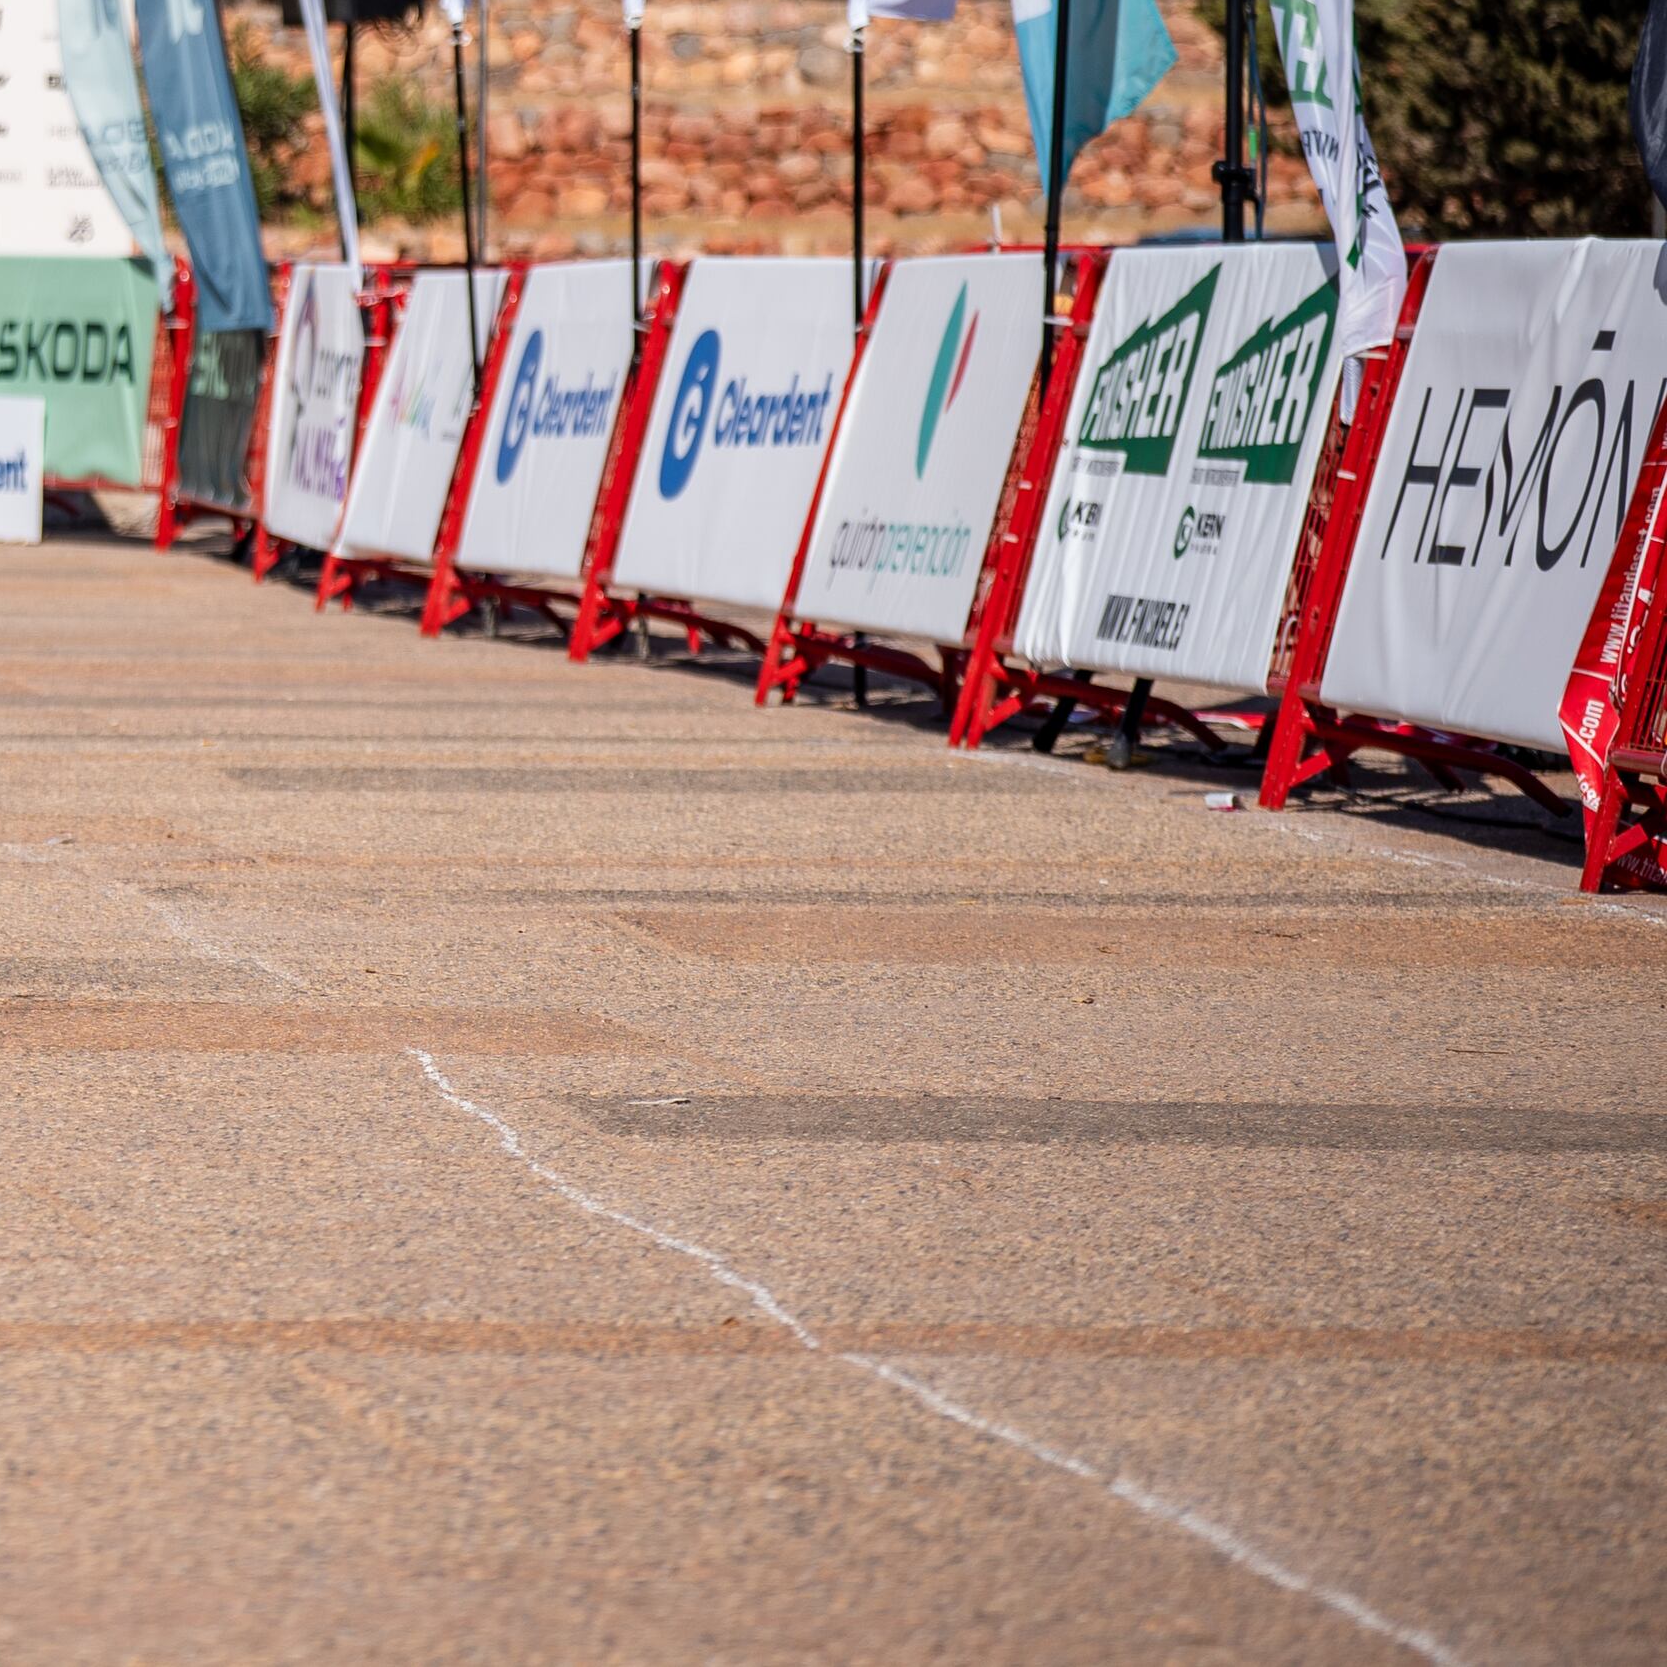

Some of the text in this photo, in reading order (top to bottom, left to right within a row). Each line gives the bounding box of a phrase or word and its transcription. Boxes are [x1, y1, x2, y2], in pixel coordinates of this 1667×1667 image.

[531, 369, 616, 442] Cleardent
[713, 371, 834, 451] Cleardent
[1080, 309, 1201, 442] FINISHER
[1201, 310, 1329, 451] FINISHER
[829, 508, 972, 594] quirónprevención
